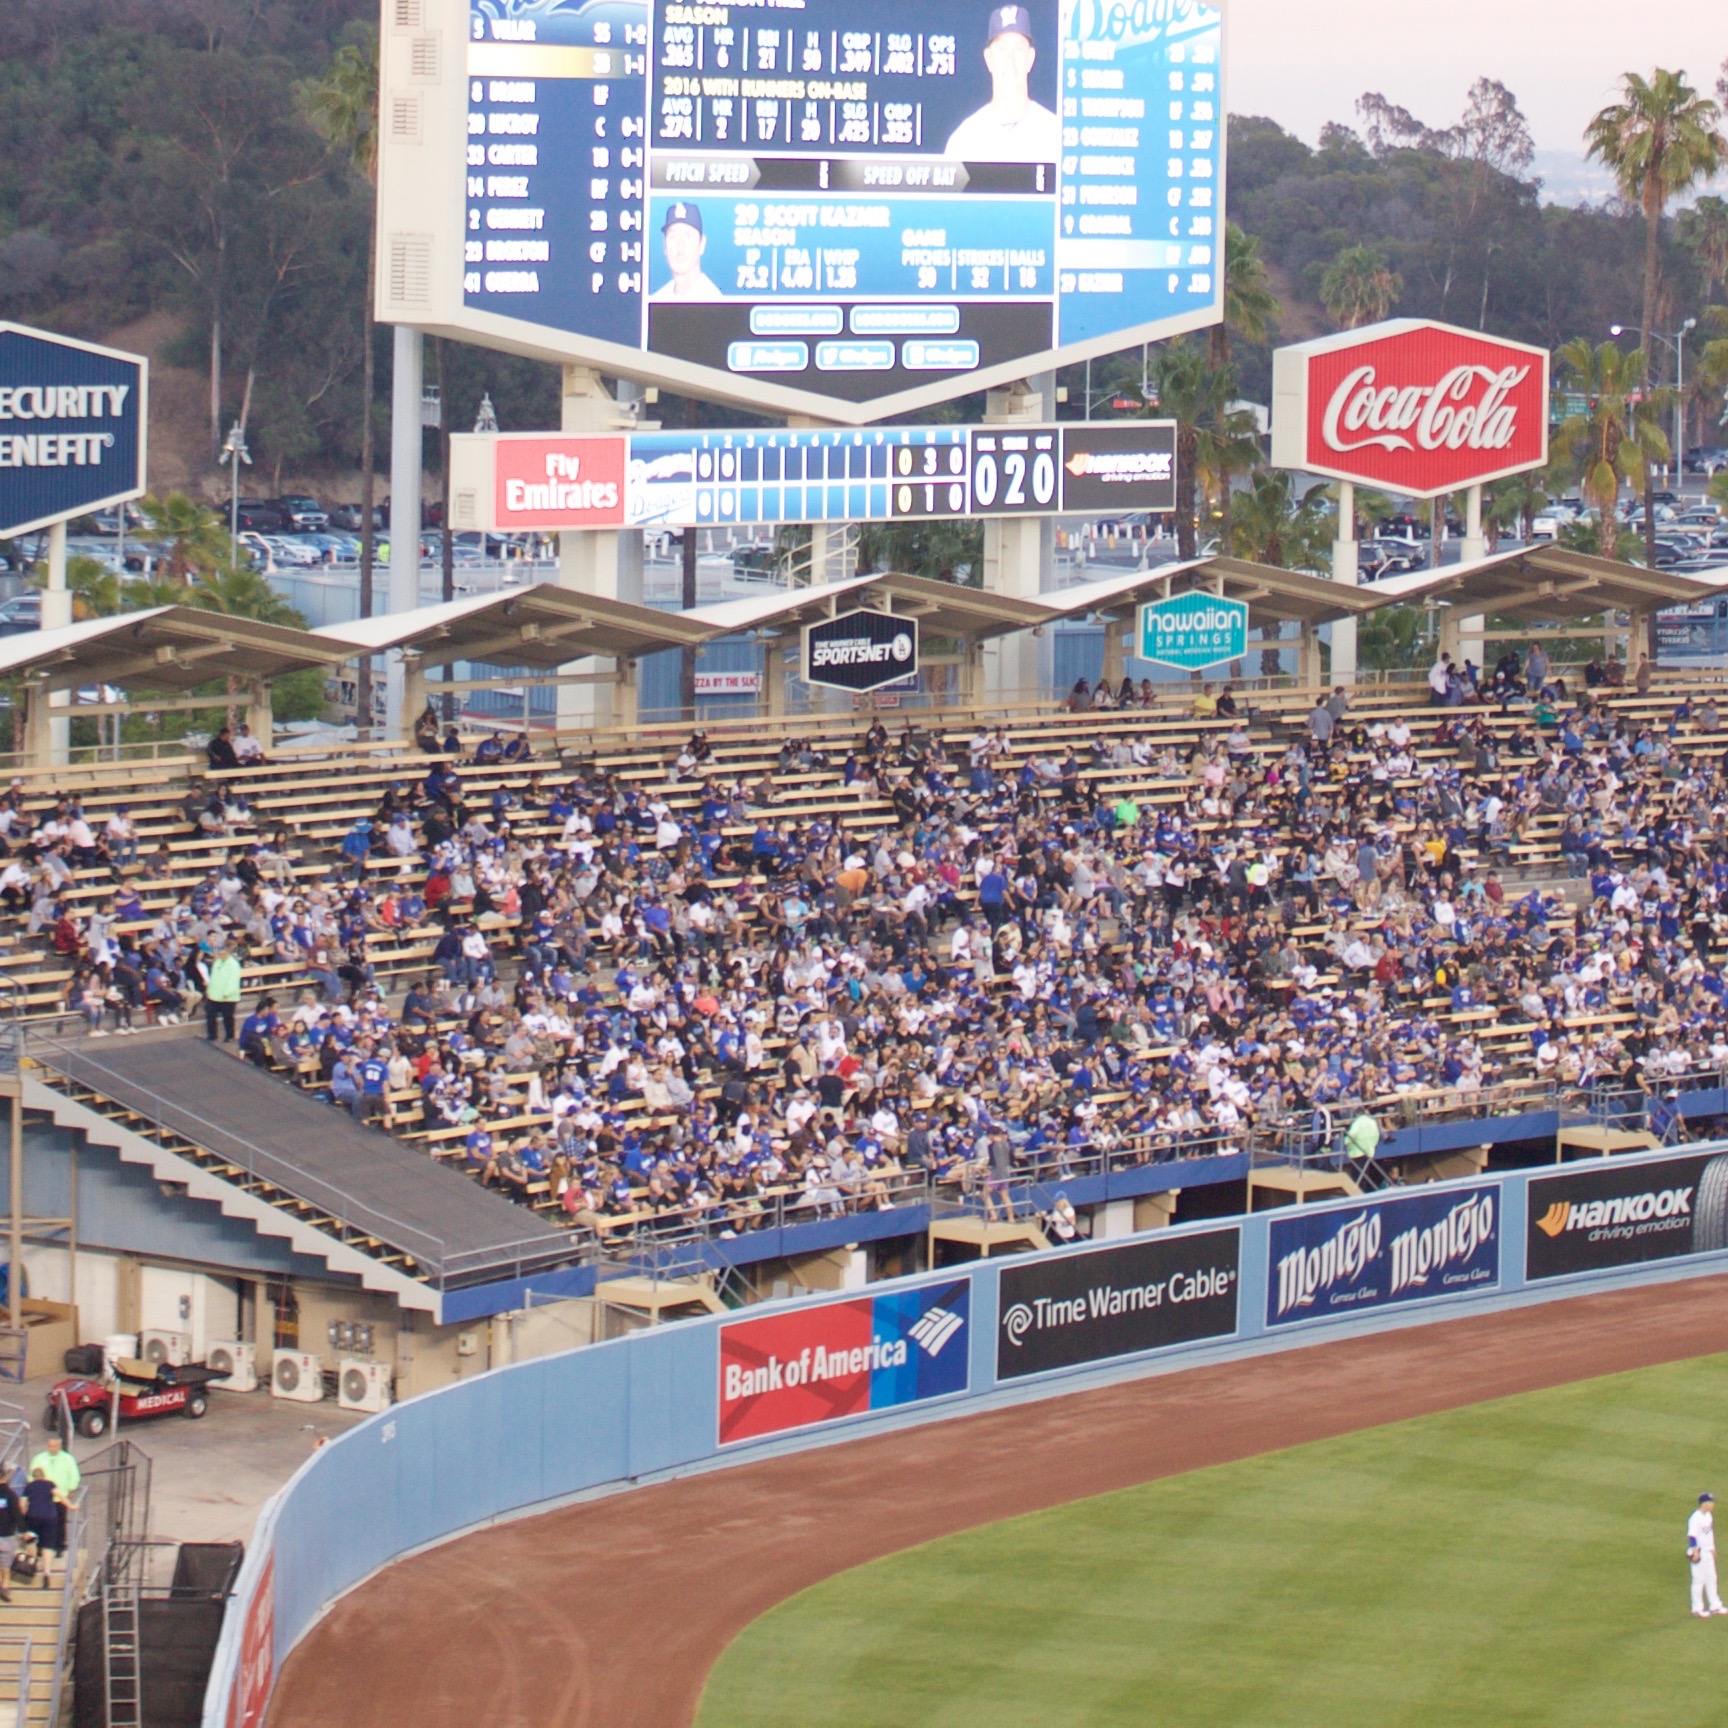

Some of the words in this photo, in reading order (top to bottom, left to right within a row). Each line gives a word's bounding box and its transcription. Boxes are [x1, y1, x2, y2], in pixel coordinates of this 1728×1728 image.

[665, 5, 728, 25] SEASON
[664, 26, 693, 43] AVG
[714, 27, 734, 45] HR
[807, 31, 818, 48] H
[843, 32, 870, 49] OBP
[888, 34, 911, 51] SLG
[928, 35, 955, 52] OPS
[625, 54, 644, 75] 1-1
[718, 46, 728, 67] 6
[758, 47, 775, 69] 21
[664, 76, 700, 95] 2016
[702, 78, 739, 96] WITH
[741, 79, 805, 98] RUNNERS
[807, 81, 867, 100] ON-BASE
[661, 98, 692, 115] AVG
[712, 99, 732, 116] HR
[806, 101, 817, 118] H
[843, 101, 867, 119] SLG
[884, 103, 912, 120] OBP
[717, 117, 727, 139] 2
[758, 118, 776, 140] 17
[666, 162, 705, 183] PITCH
[708, 163, 749, 184] SPEED
[863, 166, 903, 185] SPEED
[905, 167, 931, 186] OFF
[932, 168, 957, 187] BAT
[734, 204, 760, 226] 29
[763, 205, 819, 227] SCOTT
[820, 205, 890, 228] KAZMIR
[734, 228, 795, 247] SEASON
[902, 229, 946, 247] GAME
[746, 249, 760, 266] IP
[784, 249, 810, 267] ERA
[823, 249, 859, 267] WHIP
[902, 250, 951, 267] PITCHES
[957, 250, 1004, 267] STRIKES
[1009, 250, 1045, 267] BALLS
[736, 266, 768, 288] 75.2
[1323, 364, 1531, 452] Coca-Cola
[545, 452, 580, 479] Fly
[699, 453, 712, 478] 0
[721, 453, 734, 478] 0
[899, 448, 912, 475] 0
[924, 448, 937, 475] 3
[950, 447, 963, 474] 0
[976, 455, 997, 506] 0
[1005, 454, 1026, 504] 2
[1033, 453, 1055, 504] 0
[506, 478, 619, 510] Emirates
[698, 490, 712, 516] 0
[721, 490, 734, 516] 0
[899, 485, 912, 512] 0
[925, 485, 934, 511] 1
[950, 484, 963, 510] 0
[1148, 607, 1242, 633] hawaiian
[1156, 632, 1232, 647] SPRINGS
[812, 643, 893, 667] SPORTSNET
[725, 677, 739, 686] THE
[1588, 1225, 1634, 1242] driving
[1635, 1216, 1691, 1236] emotion
[1277, 1210, 1382, 1319] Montejo
[1390, 1192, 1494, 1297] Montejo
[1033, 1298, 1086, 1330] Time
[1089, 1283, 1167, 1320] Warner
[1168, 1267, 1229, 1304] Cable
[725, 1355, 784, 1402] Bank
[785, 1348, 810, 1387] of
[811, 1335, 907, 1382] America
[136, 1390, 186, 1411] MEDICAL
